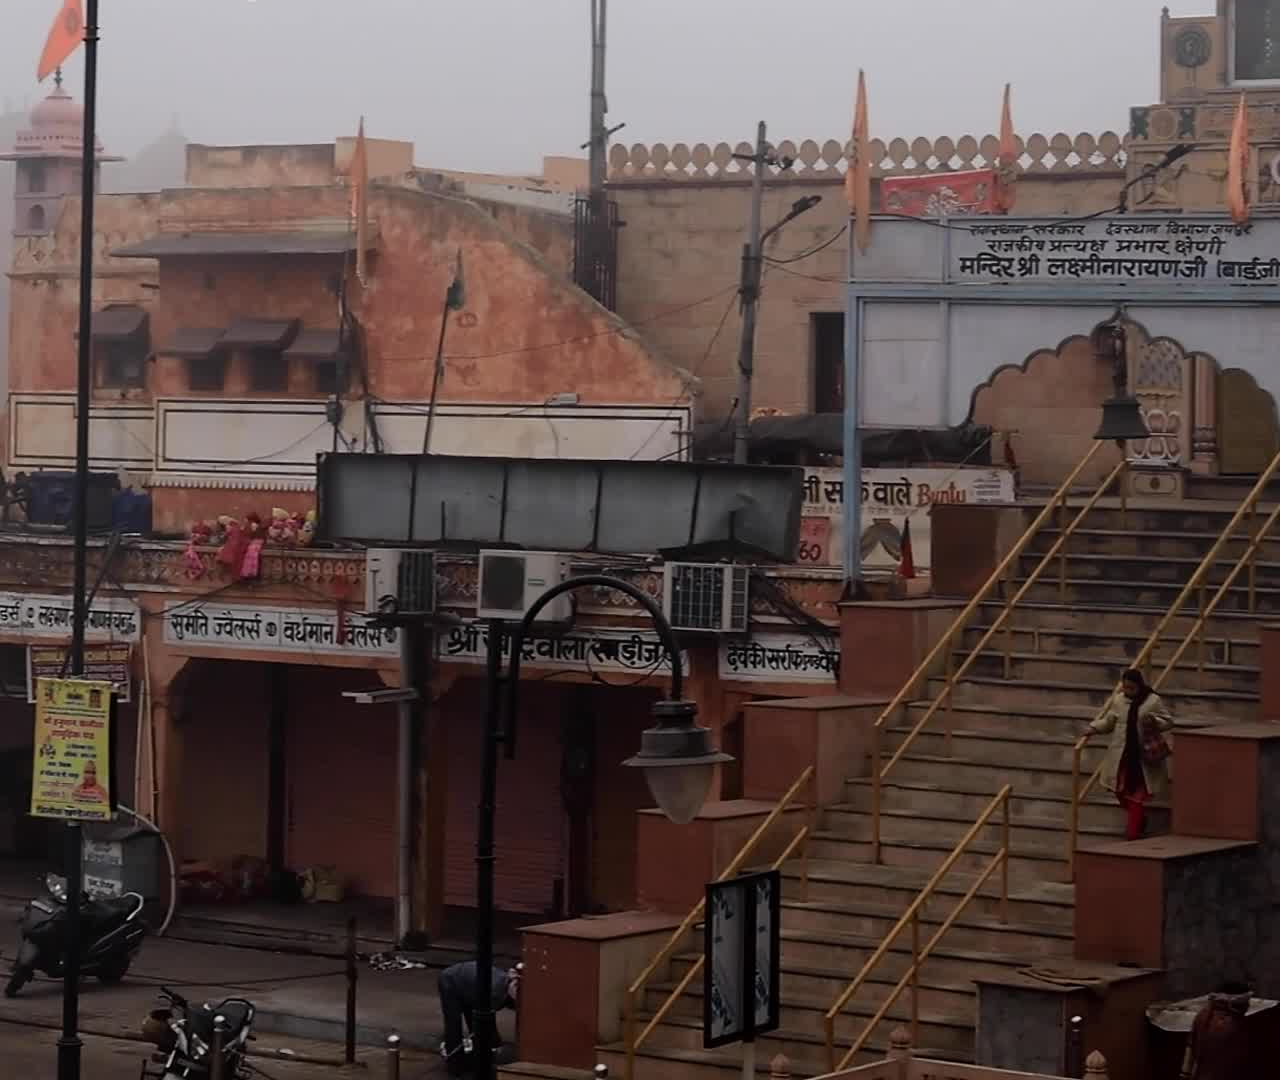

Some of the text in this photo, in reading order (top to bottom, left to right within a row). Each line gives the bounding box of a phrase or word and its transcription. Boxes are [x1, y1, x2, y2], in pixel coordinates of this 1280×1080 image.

[1033, 224, 1086, 236] सरकार
[1106, 221, 1160, 236] देवस्थान
[986, 236, 1045, 253] राजकीय
[1049, 239, 1108, 253] प्रत्यक्ष
[1116, 239, 1169, 254] प्रभार
[959, 253, 1015, 277] मन्दिर
[1018, 254, 1041, 277] श्री
[872, 477, 912, 505] वाले
[171, 609, 262, 640] सुमति ज्वैलर्स
[284, 617, 335, 644] वर्धमान
[448, 626, 478, 655] श्री
[728, 641, 766, 671] देवकी
